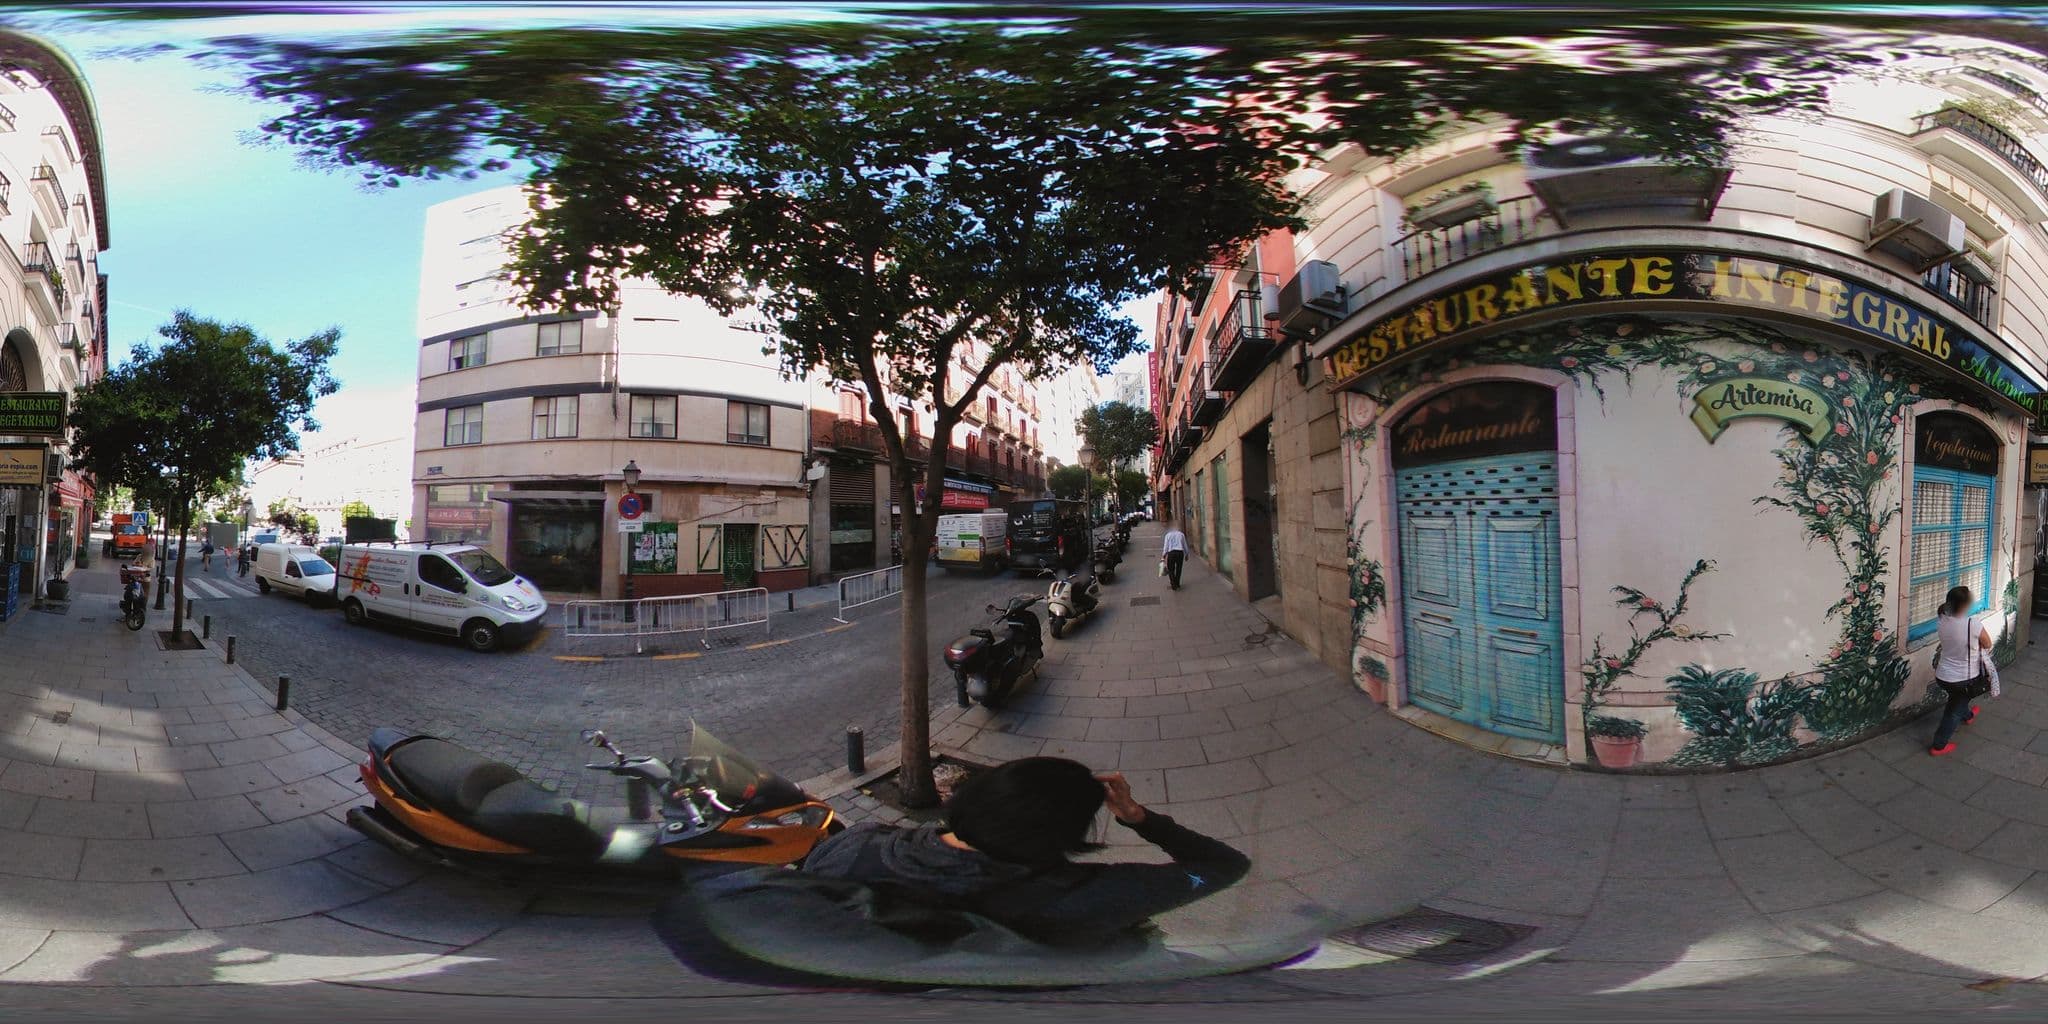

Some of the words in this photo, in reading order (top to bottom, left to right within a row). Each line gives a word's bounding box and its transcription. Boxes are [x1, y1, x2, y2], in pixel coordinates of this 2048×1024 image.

[1333, 256, 1675, 382] RESTAURANTE
[1711, 259, 1951, 360] INTEGRAL
[1711, 383, 1814, 415] Artemisa
[1961, 354, 2034, 411] Artemisa
[1402, 409, 1541, 454] Restaurante
[1924, 429, 1992, 462] Vegetariano
